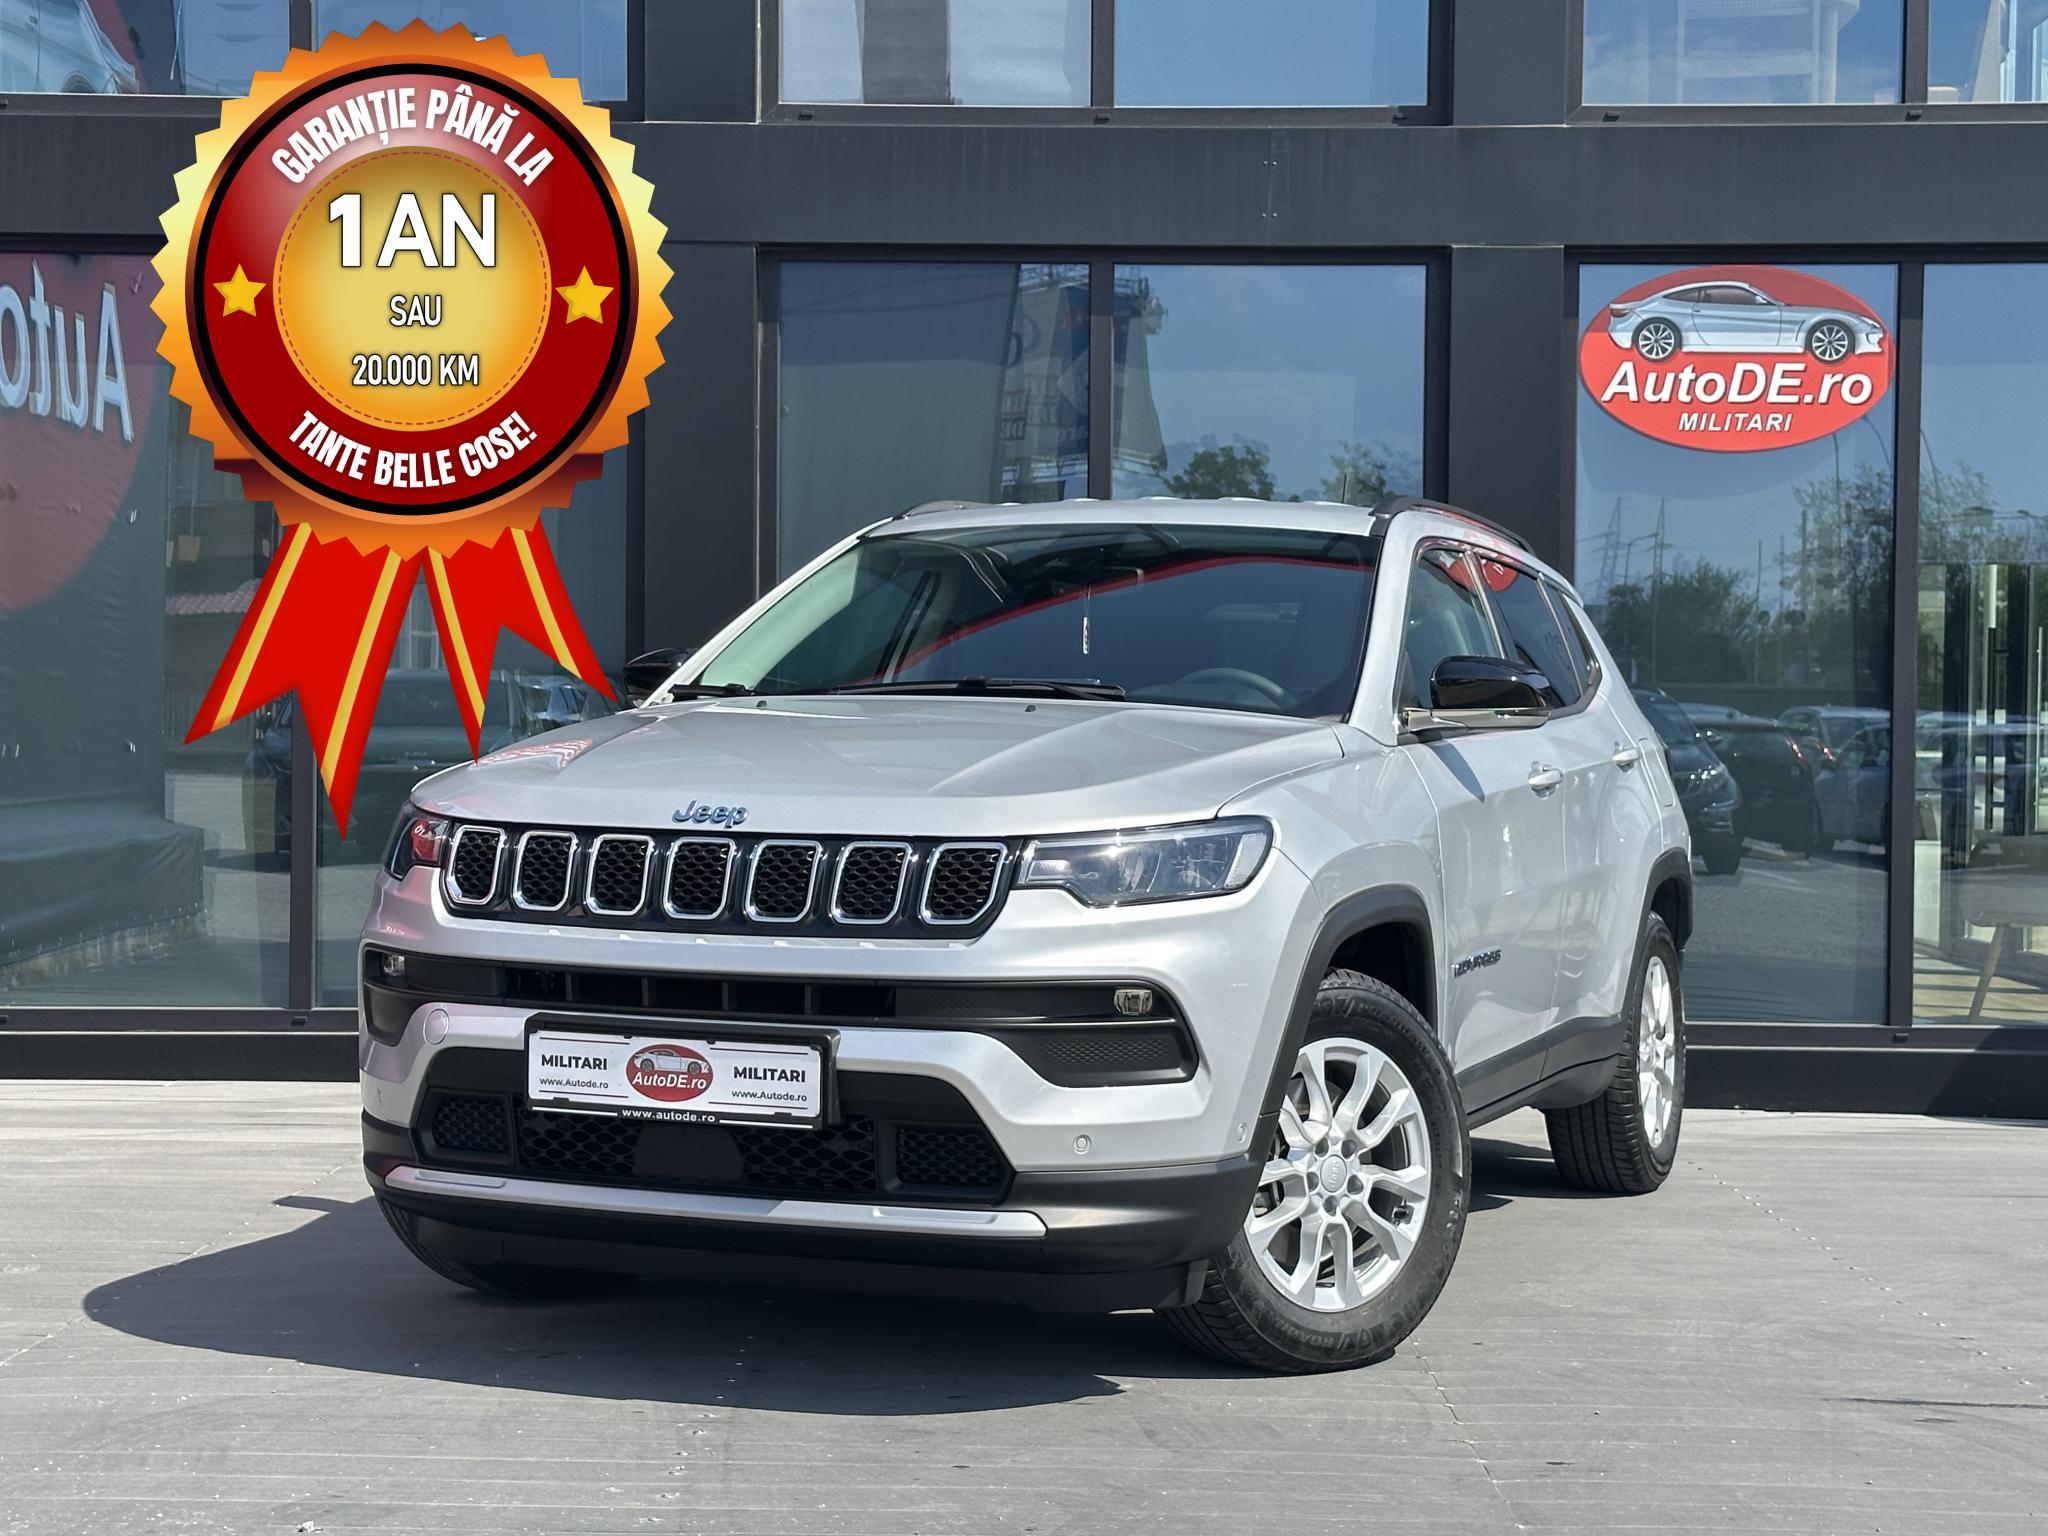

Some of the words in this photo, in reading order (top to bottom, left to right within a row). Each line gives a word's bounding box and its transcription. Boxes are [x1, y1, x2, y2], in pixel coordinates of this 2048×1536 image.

[1600, 360, 1873, 405] AutoDE.ro
[1678, 412, 1793, 433] MILITARI
[672, 799, 748, 829] Jeep
[541, 1054, 608, 1071] MILITARI
[539, 1077, 609, 1089] www.Autode.ro
[632, 1071, 707, 1090] AutoDE.ro
[733, 1066, 806, 1083] MILITARI
[731, 1089, 808, 1102] www.Autode.ro
[621, 1108, 716, 1123] www.autode.ro
